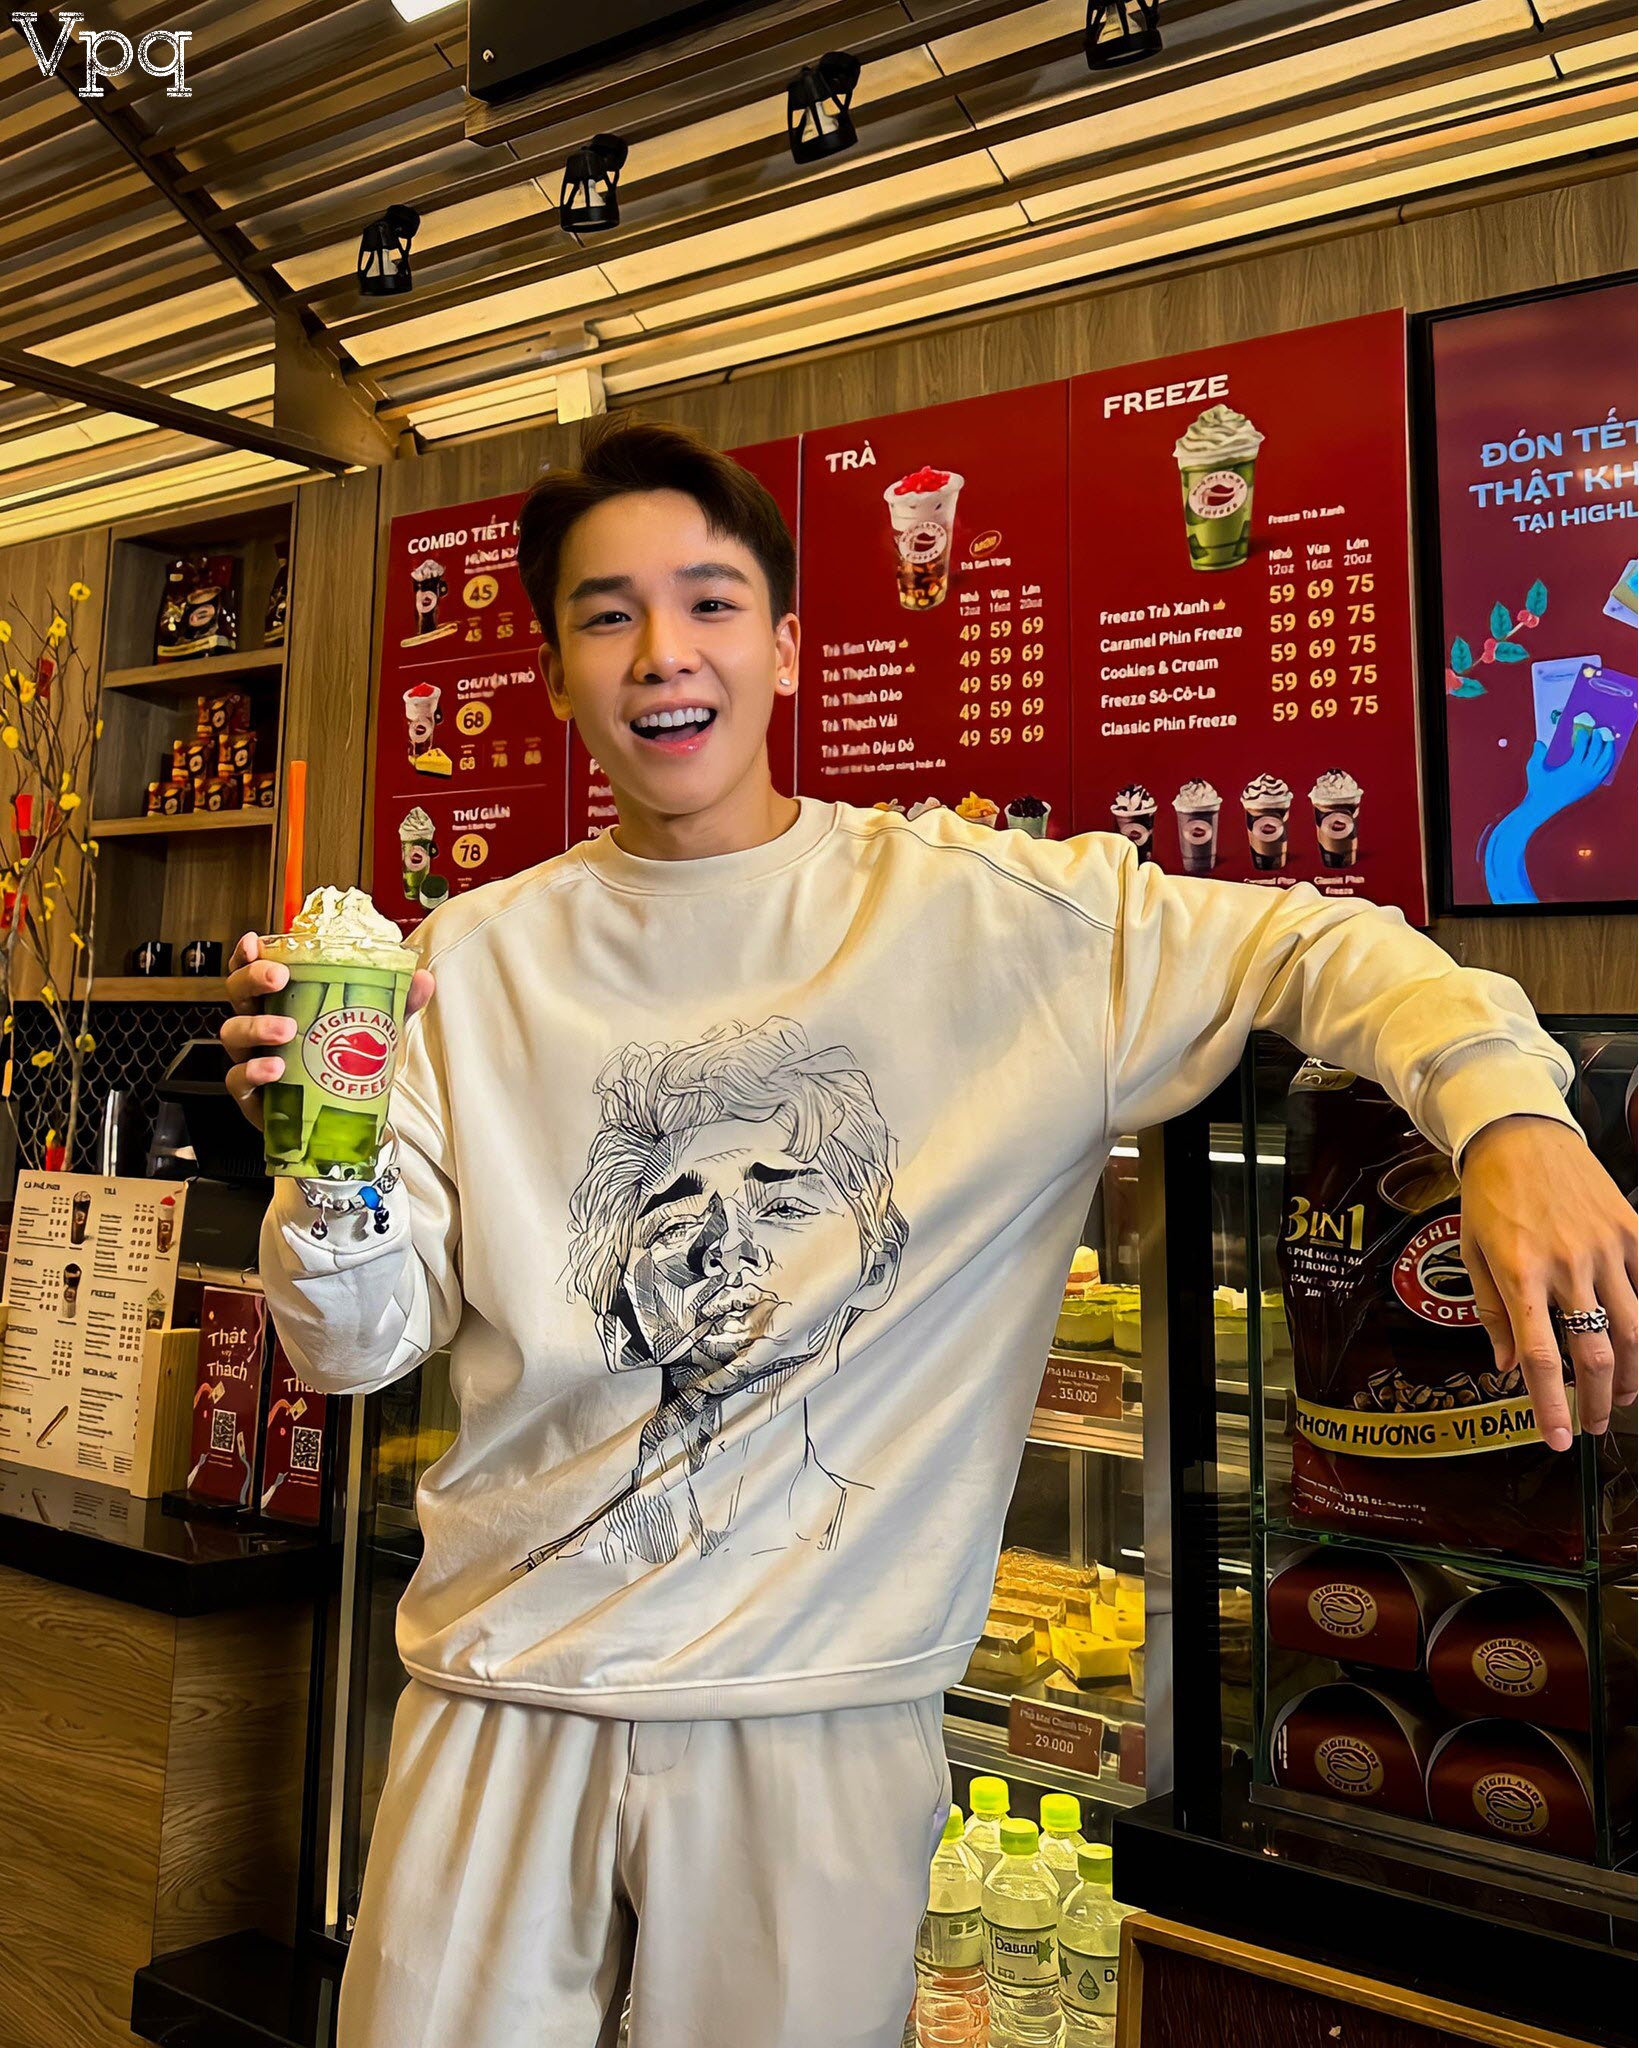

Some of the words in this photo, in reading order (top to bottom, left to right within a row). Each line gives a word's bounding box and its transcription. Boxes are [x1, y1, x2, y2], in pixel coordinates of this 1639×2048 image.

[1103, 374, 1230, 419] FREEZE
[825, 440, 877, 473] TRÀ
[1480, 428, 1563, 468] ĐÓN
[1468, 468, 1574, 509] THẬT
[1512, 511, 1555, 535] TẠI
[407, 530, 468, 555] COMBO
[469, 584, 493, 602] 45
[1269, 583, 1296, 604] 59
[1306, 578, 1335, 600] 69
[1346, 573, 1375, 595] 75
[1100, 611, 1146, 626] Freeze
[1173, 598, 1210, 616] Xanh
[1269, 613, 1296, 634] 59
[1307, 608, 1336, 629] 69
[1347, 603, 1376, 625] 75
[959, 624, 981, 641] 49
[990, 620, 1012, 639] 59
[1022, 616, 1044, 635] 69
[1100, 631, 1157, 653] Caramel
[1159, 629, 1192, 646] Phin
[1194, 626, 1243, 643] Freeze
[959, 650, 981, 668] 49
[990, 646, 1012, 666] 59
[1022, 643, 1044, 662] 69
[1270, 642, 1298, 663] 59
[1308, 638, 1337, 659] 69
[1348, 633, 1377, 655] 75
[1100, 661, 1156, 681] Cookies
[1157, 660, 1169, 674] &
[1171, 656, 1219, 673] Cream
[1271, 672, 1298, 693] 59
[1309, 668, 1337, 690] 69
[1348, 664, 1378, 685] 75
[959, 676, 981, 694] 49
[990, 673, 1012, 691] 59
[1022, 670, 1044, 689] 69
[959, 703, 981, 720] 49
[990, 700, 1012, 718] 59
[1022, 697, 1044, 716] 69
[1101, 693, 1147, 708] Freeze
[1272, 702, 1299, 722] 59
[1310, 698, 1338, 719] 69
[1349, 695, 1379, 716] 75
[463, 711, 484, 729] 68
[1101, 719, 1151, 737] Classic
[1153, 715, 1186, 733] Phin
[1188, 713, 1238, 729] Freeze
[959, 729, 981, 747] 49
[990, 727, 1012, 745] 59
[1022, 724, 1044, 743] 69
[459, 844, 481, 862] 78
[207, 1326, 248, 1348] Thật
[1059, 1387, 1098, 1404] 35.000
[1351, 1419, 1436, 1447] HƯƠNG
[1452, 1418, 1476, 1445] VỊ
[1480, 1408, 1536, 1440] ĐẬM
[1035, 1733, 1074, 1754] 29.000
